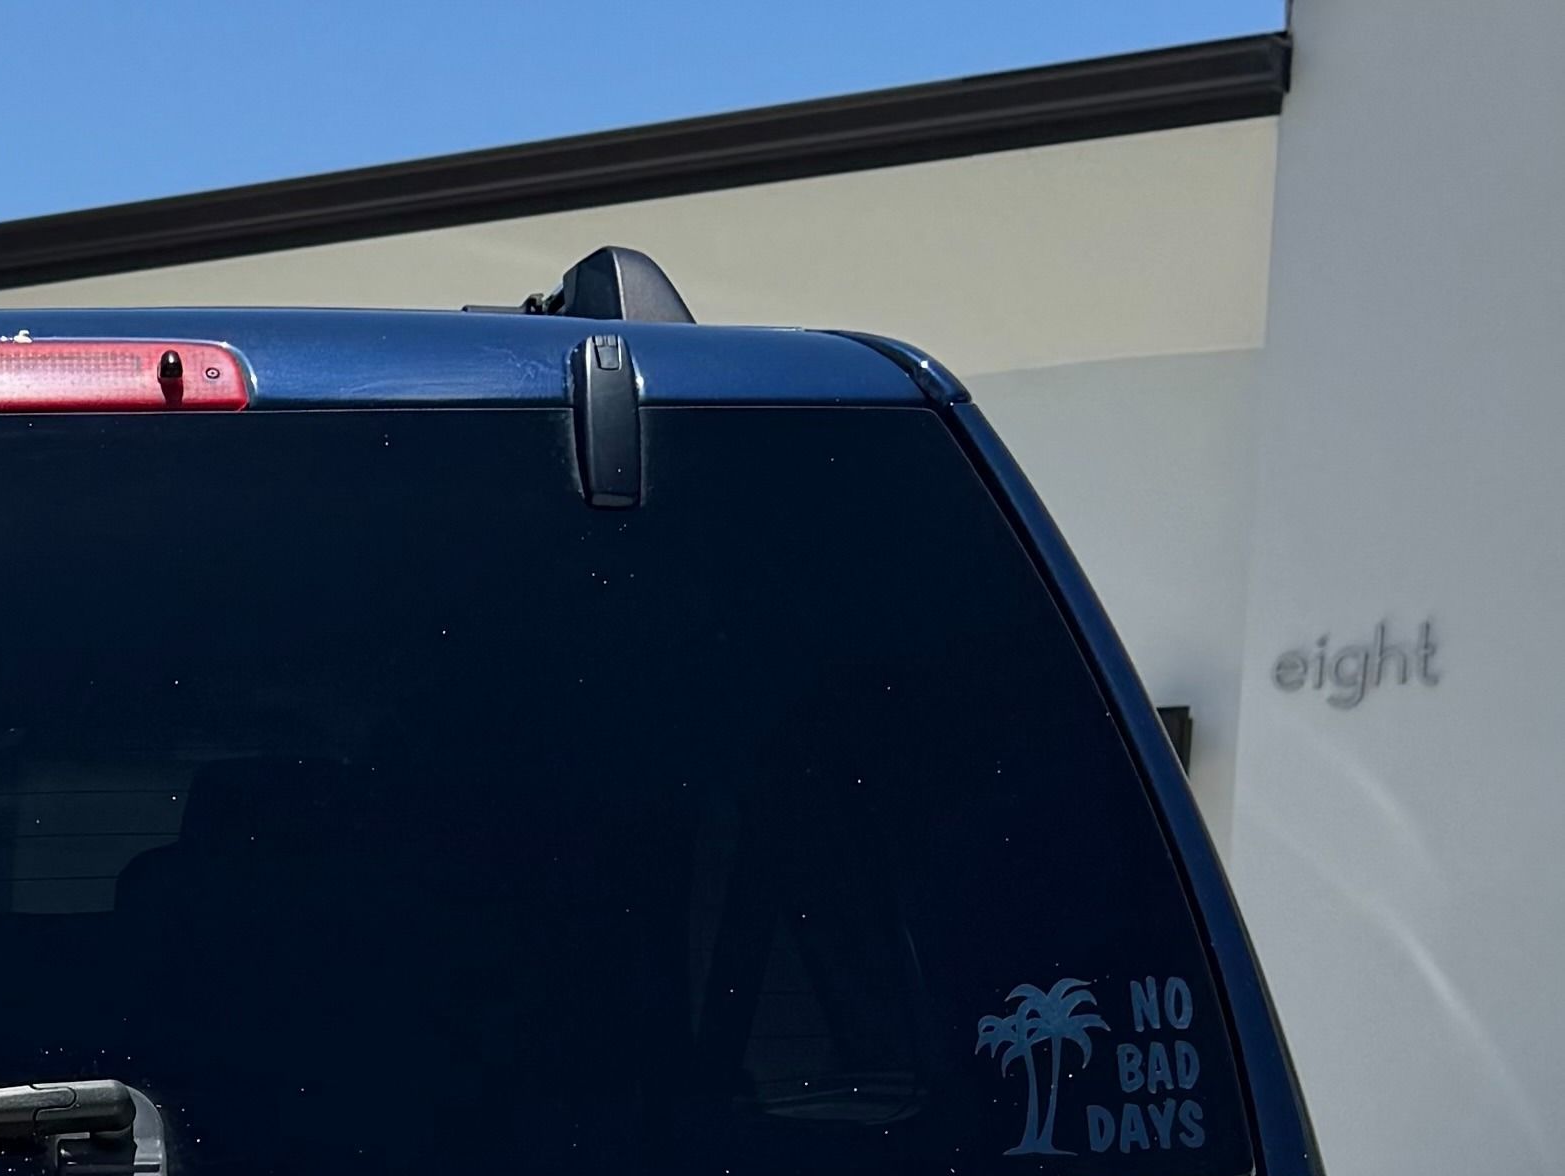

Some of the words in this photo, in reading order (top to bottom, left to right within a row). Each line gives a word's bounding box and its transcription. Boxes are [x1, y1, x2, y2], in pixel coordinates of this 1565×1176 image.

[1272, 619, 1441, 710] eight
[1130, 976, 1193, 1031] NO
[1117, 1040, 1200, 1093] BAD
[1086, 1098, 1205, 1153] DAYS
